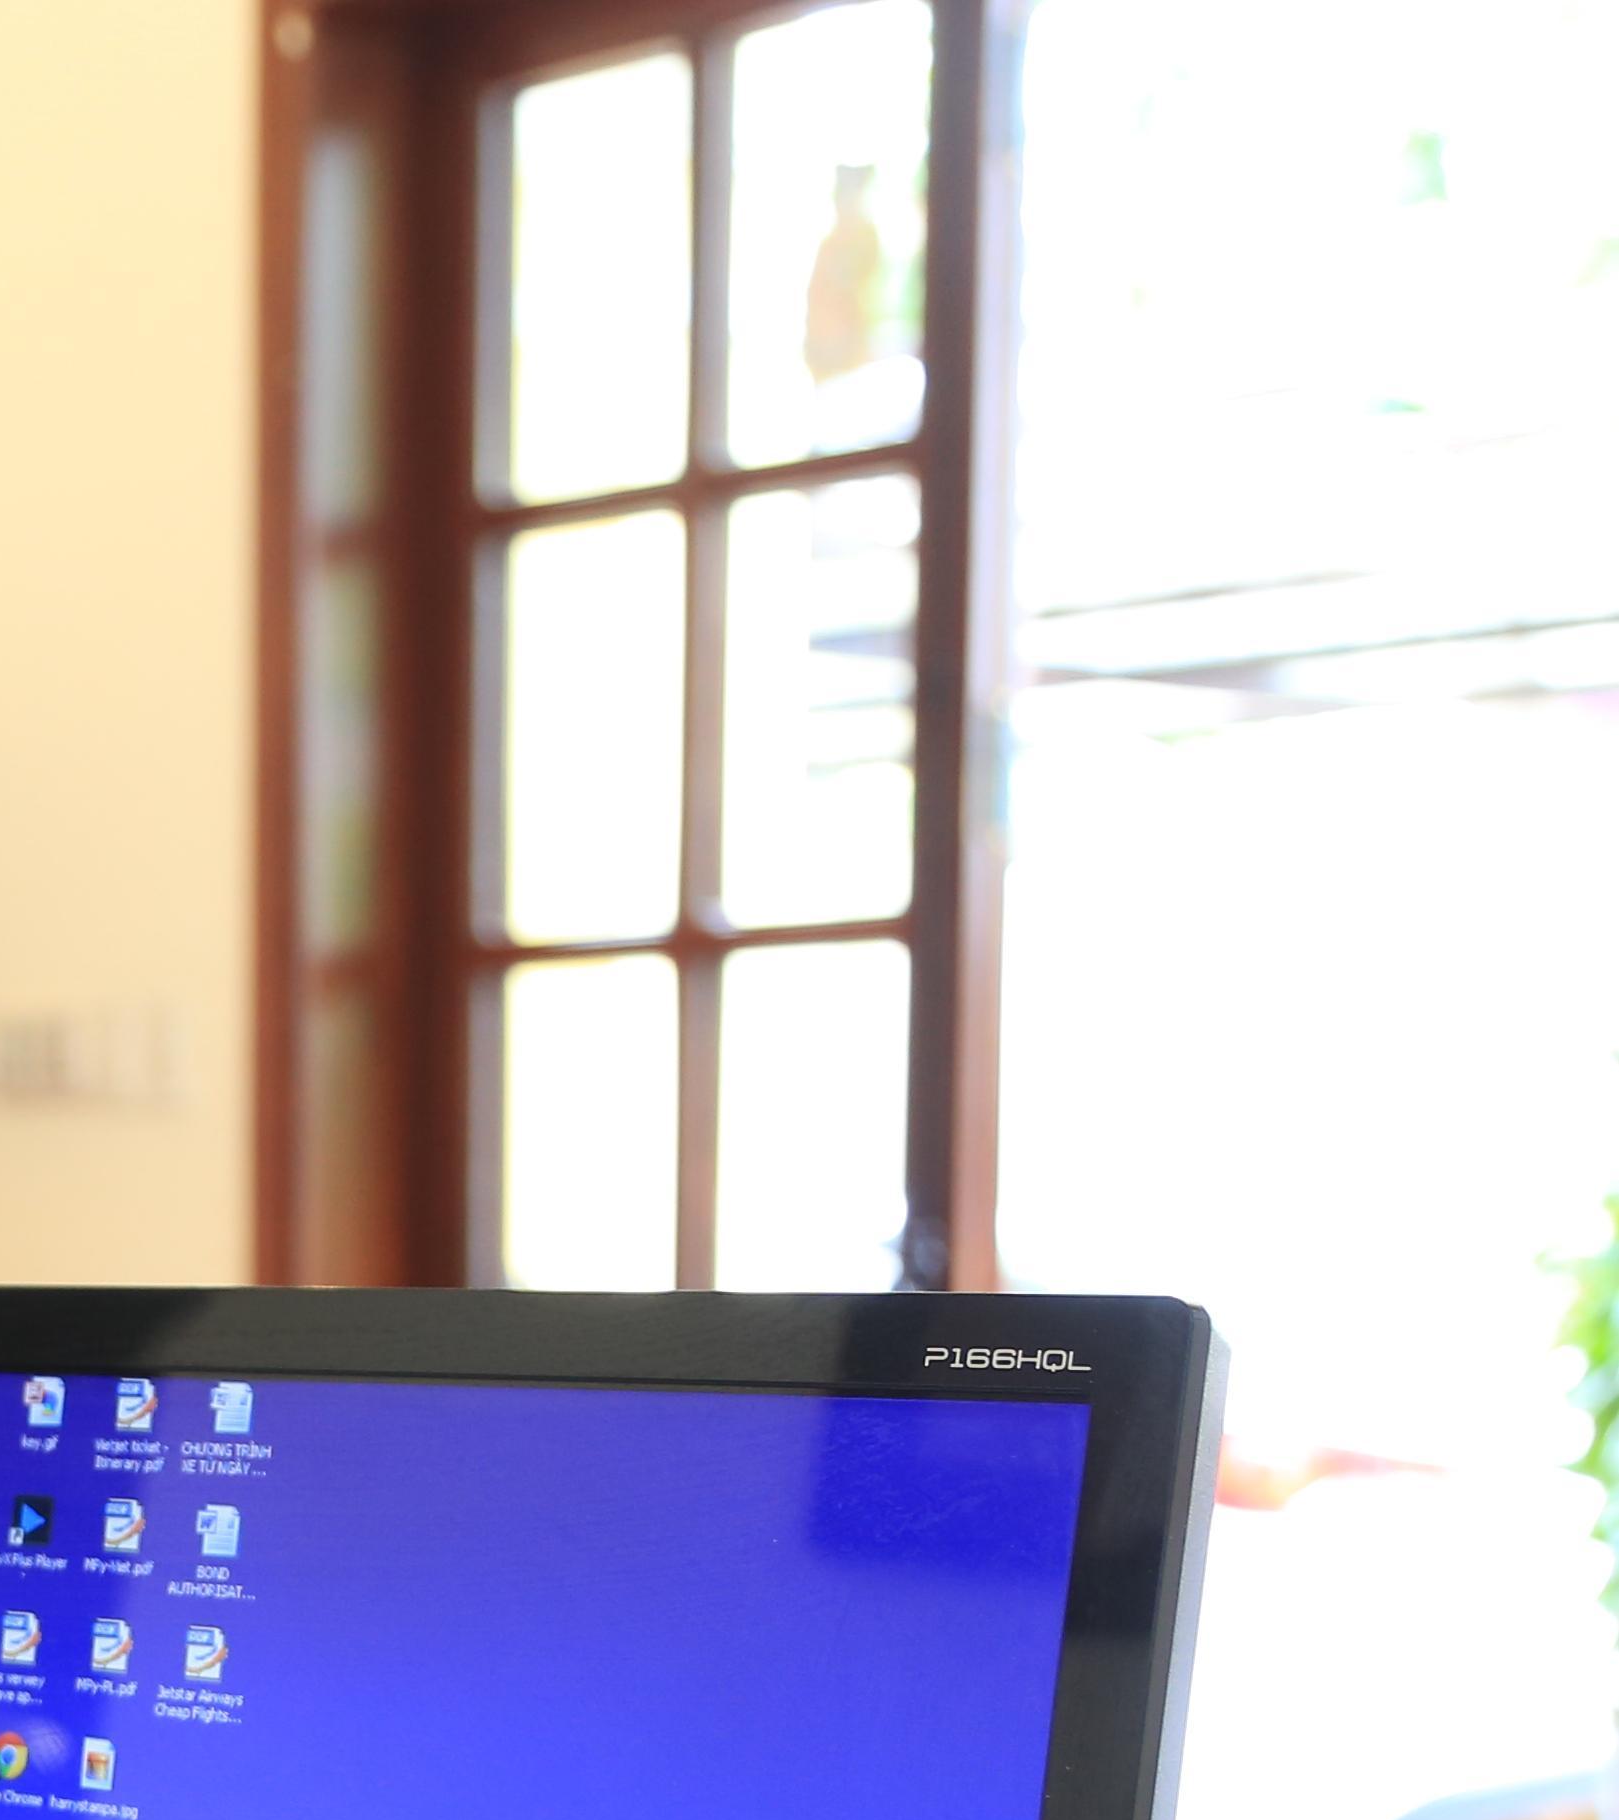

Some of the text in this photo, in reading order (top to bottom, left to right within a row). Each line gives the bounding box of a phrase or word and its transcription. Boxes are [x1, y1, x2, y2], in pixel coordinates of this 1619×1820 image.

[923, 1347, 1092, 1373] P166HQL
[36, 1553, 68, 1570] Player
[158, 1684, 244, 1707] Jetstar Airways
[155, 1703, 191, 1721] Cheap
[3, 1789, 43, 1807] Chrome
